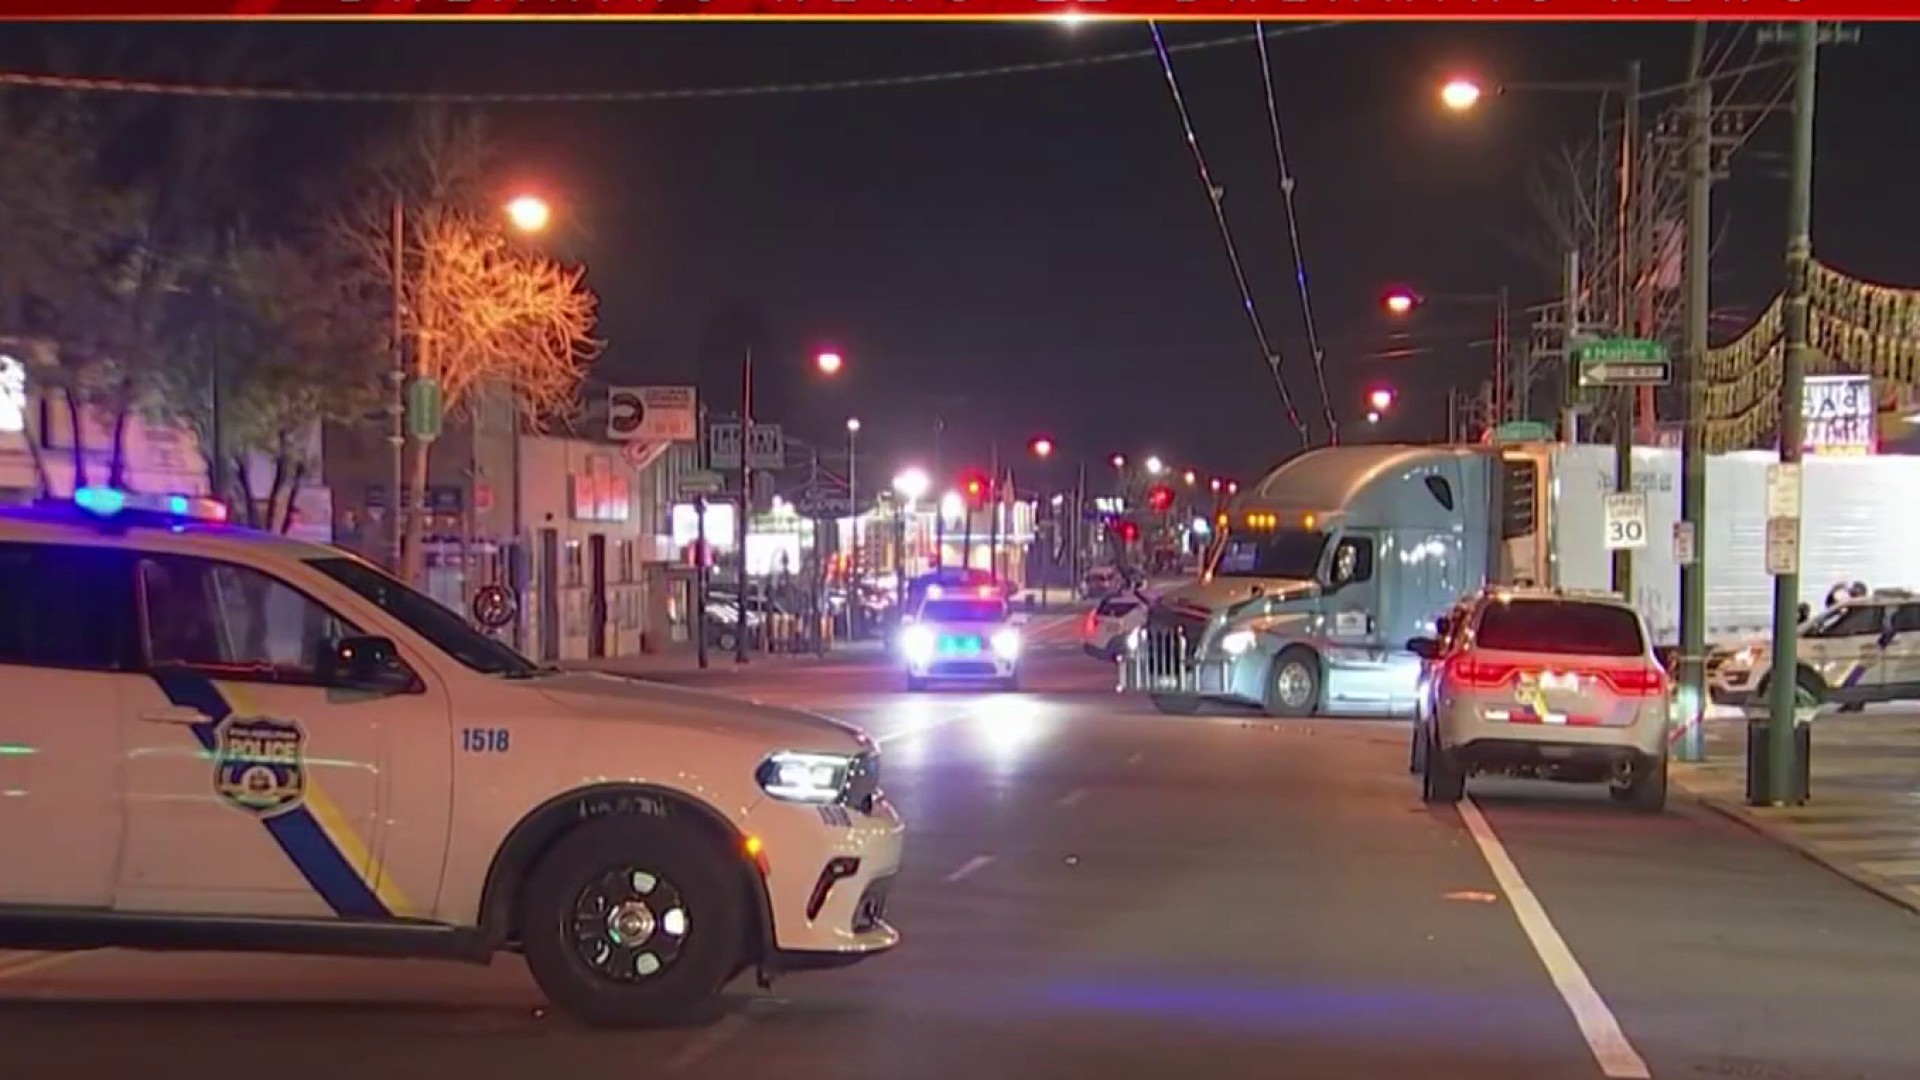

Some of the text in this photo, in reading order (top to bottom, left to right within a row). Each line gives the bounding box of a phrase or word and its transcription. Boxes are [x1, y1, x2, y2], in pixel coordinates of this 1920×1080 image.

[1609, 521, 1642, 541] 30
[230, 739, 299, 763] POLICE
[461, 728, 510, 753] 1518
